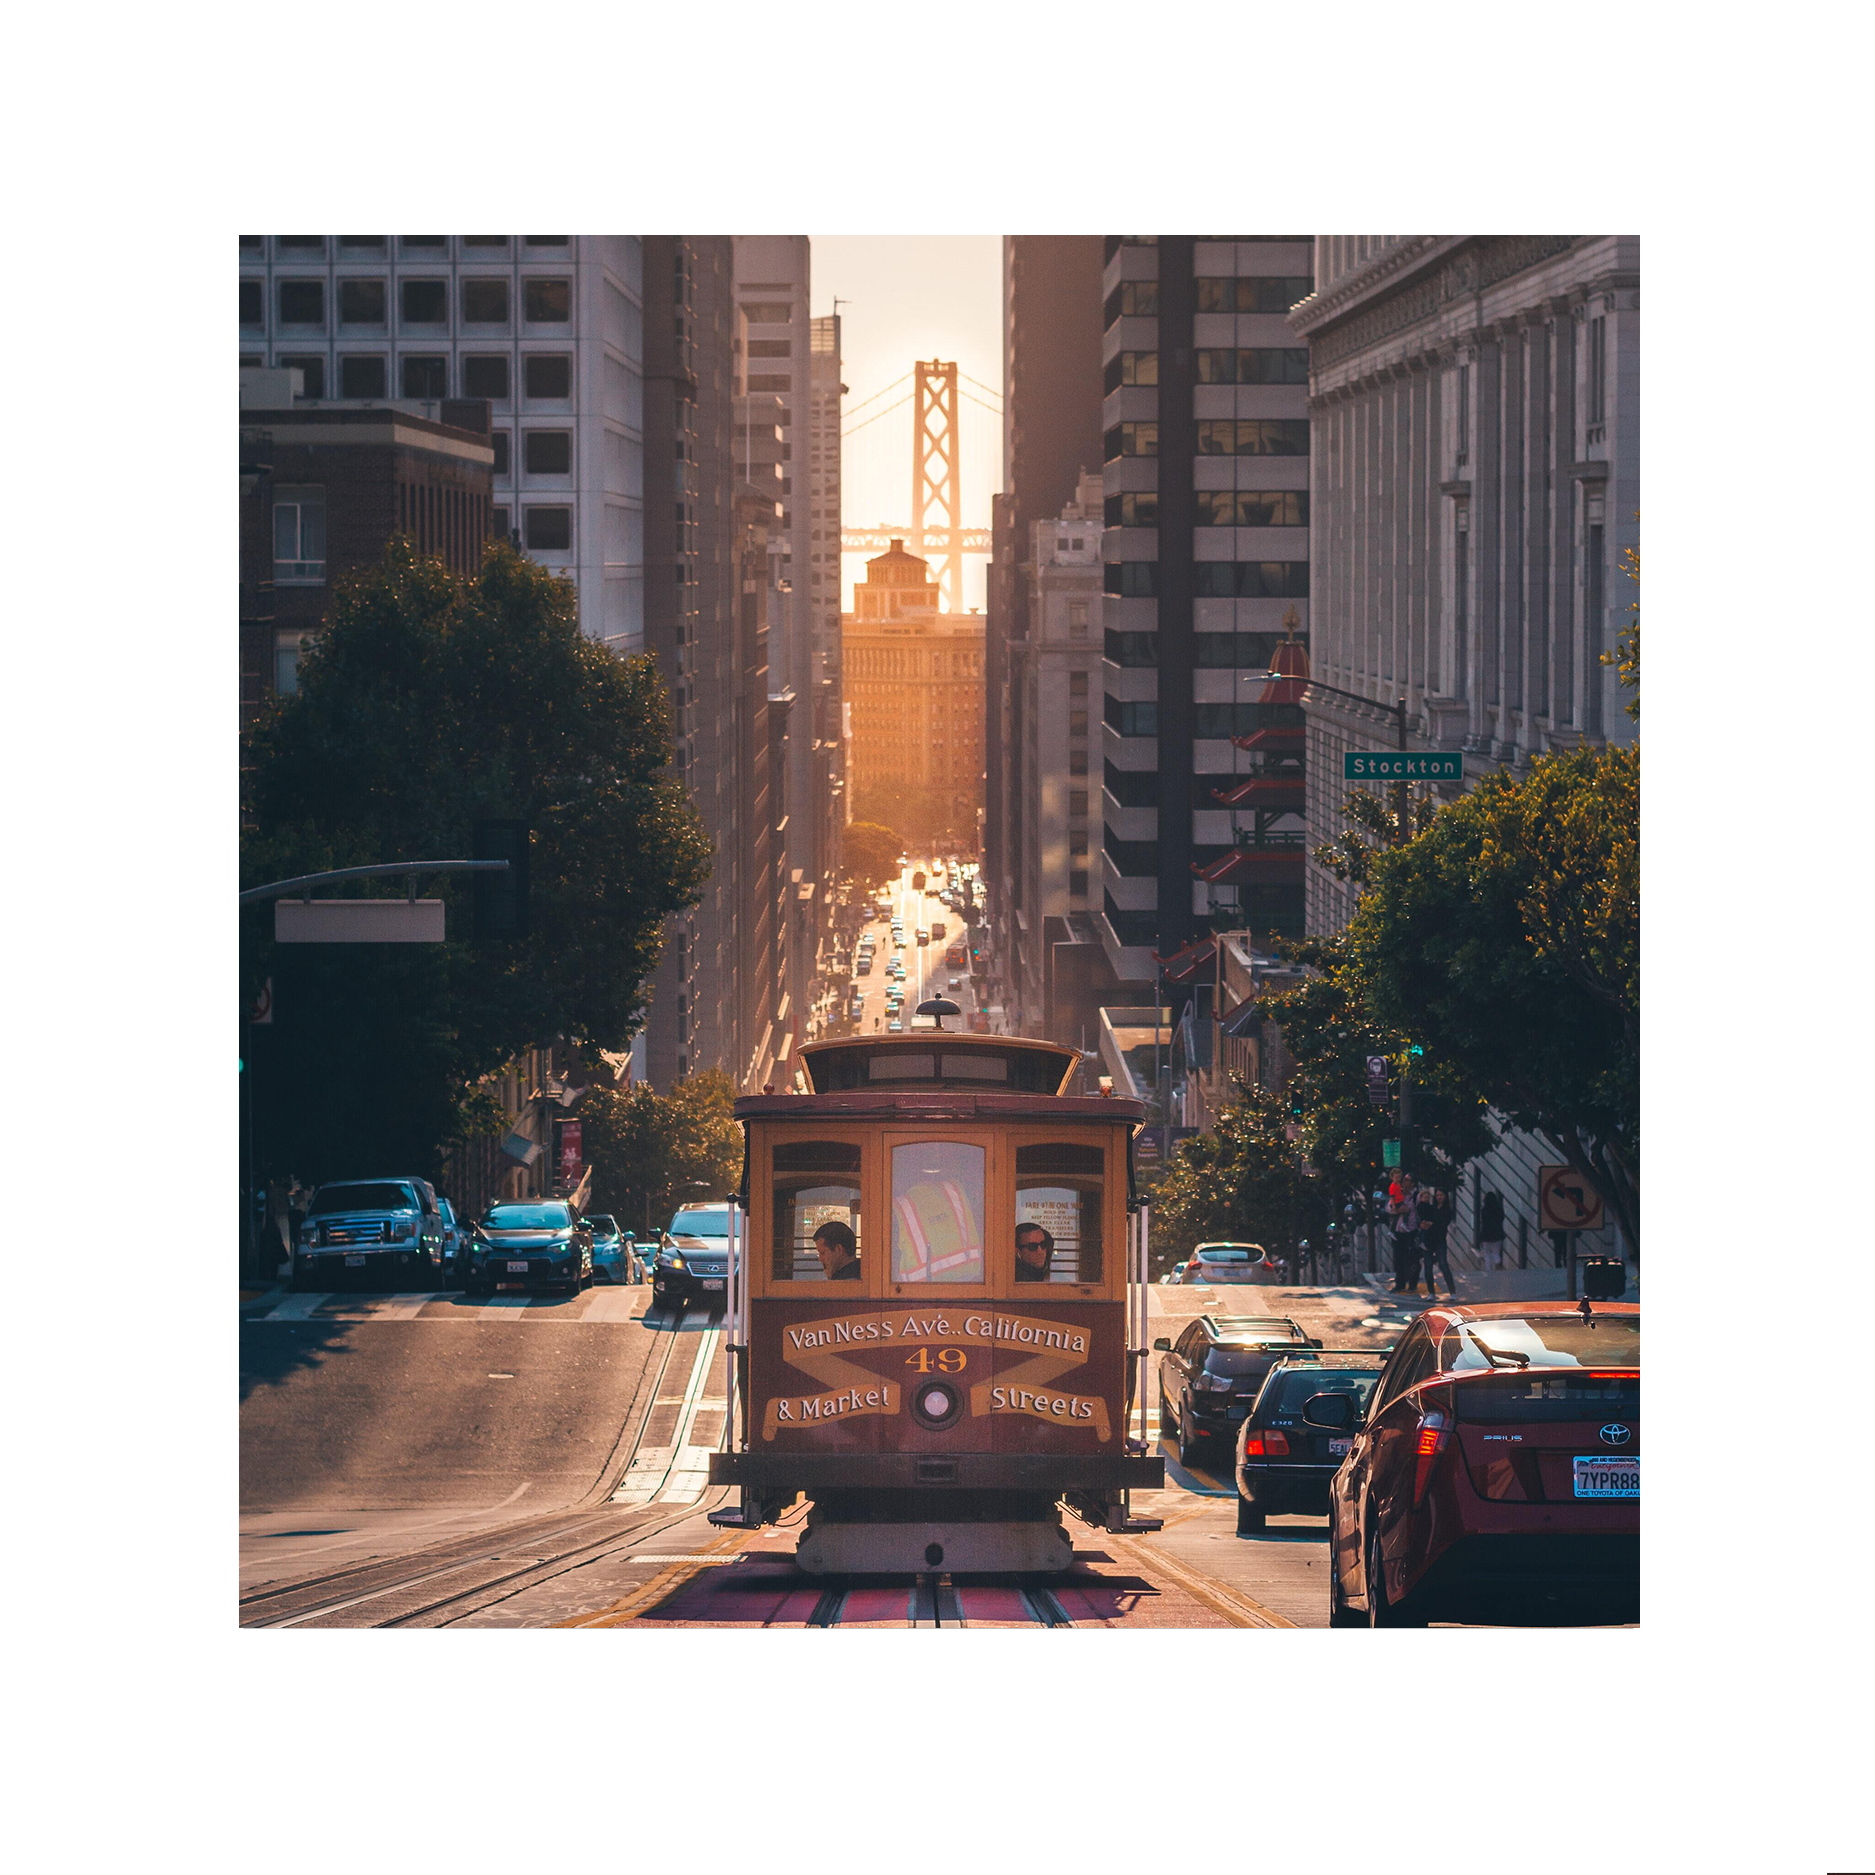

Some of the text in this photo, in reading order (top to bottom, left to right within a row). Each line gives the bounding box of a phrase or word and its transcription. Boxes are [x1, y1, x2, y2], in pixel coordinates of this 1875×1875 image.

[1353, 758, 1454, 774] Stockton
[1055, 1201, 1069, 1209] ONE
[789, 1328, 832, 1349] Van
[834, 1321, 894, 1343] Ness
[964, 1315, 1085, 1353] California
[904, 1347, 967, 1373] 49
[778, 1386, 1094, 1420] & Market Streets
